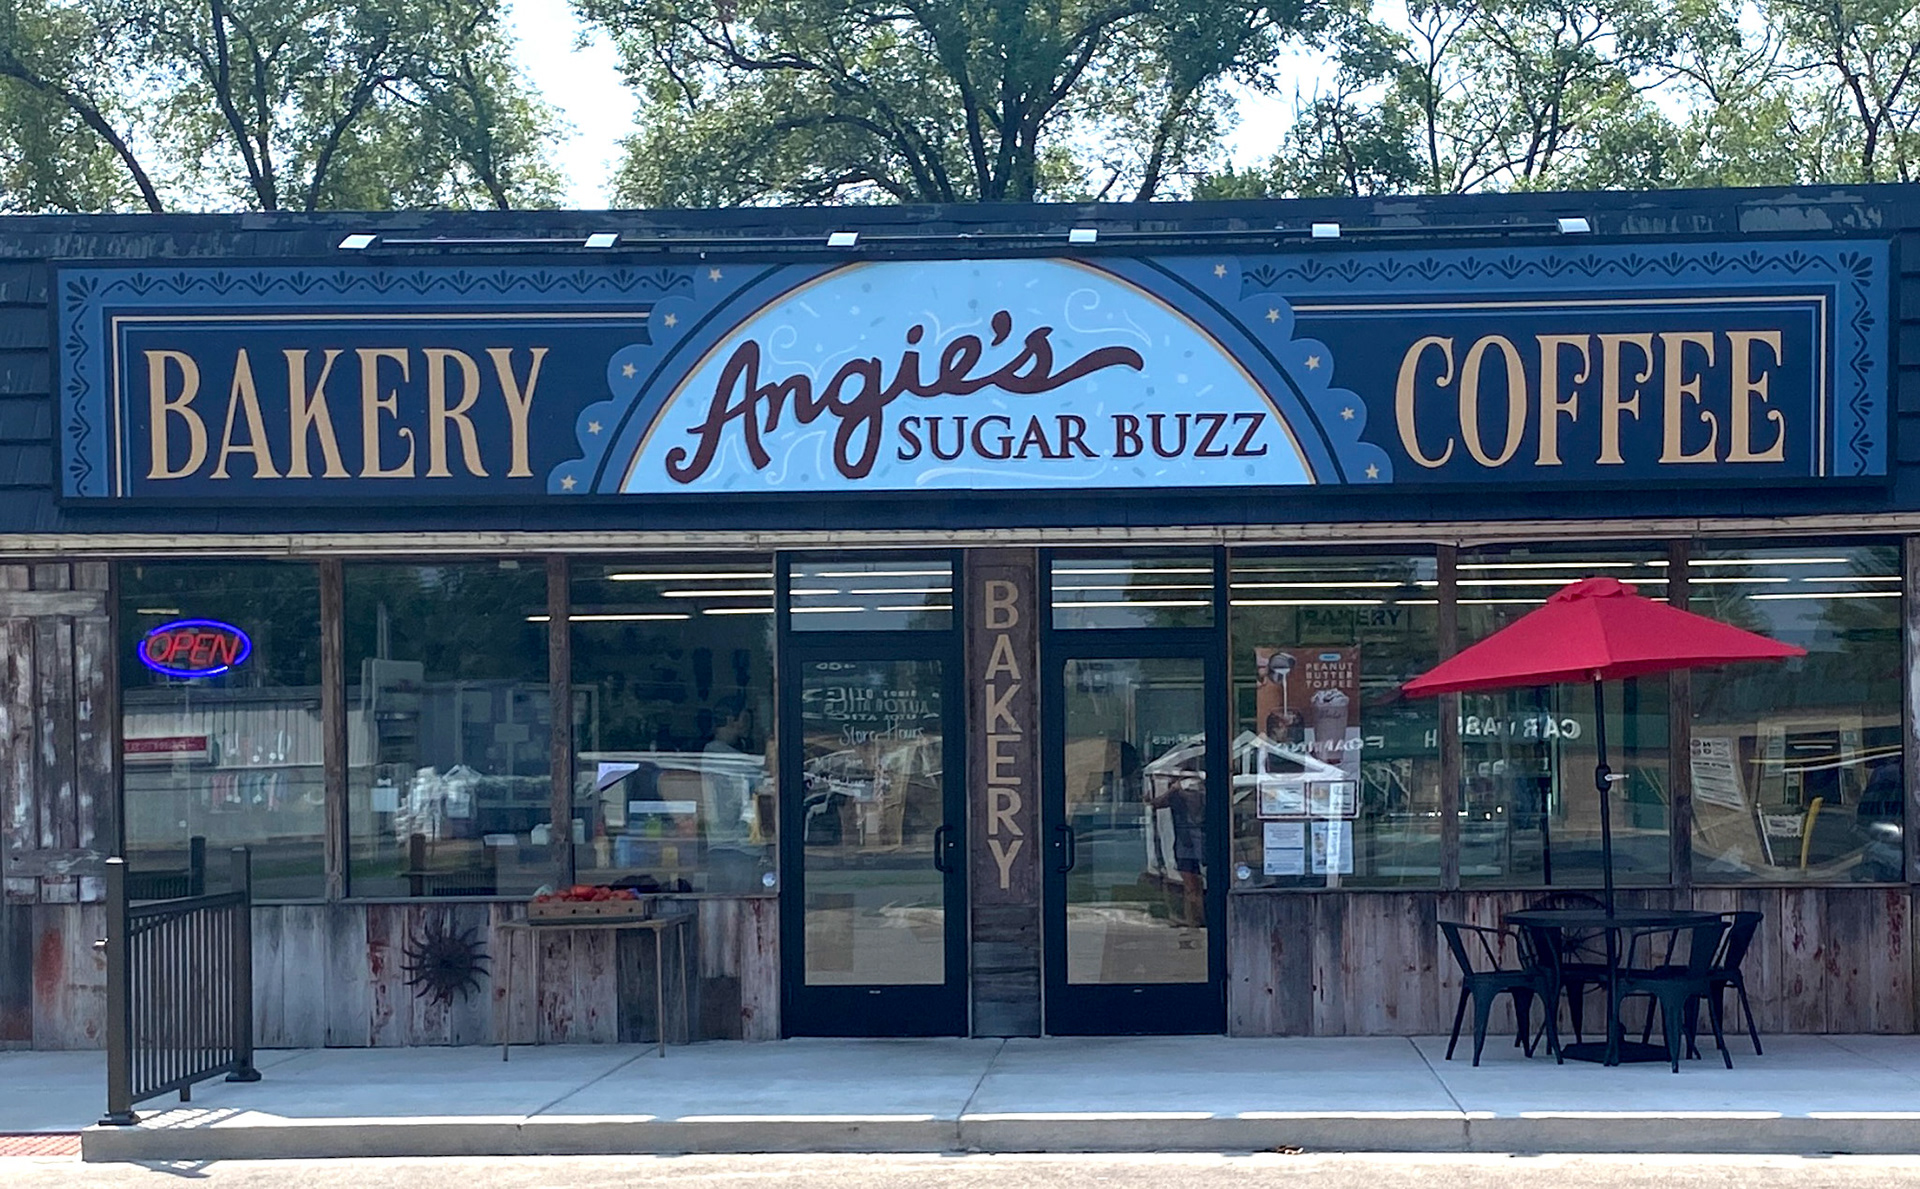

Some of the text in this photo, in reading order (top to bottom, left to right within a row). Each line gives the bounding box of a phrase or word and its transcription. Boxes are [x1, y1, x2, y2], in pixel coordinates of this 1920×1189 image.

[143, 347, 549, 480] BAKERY
[665, 310, 1144, 484] Angie's
[1395, 330, 1785, 469] COFFEE
[896, 412, 1268, 461] SUGAR BUZZ
[145, 630, 241, 666] OPEN
[1305, 662, 1354, 671] PEANUT
[1305, 671, 1354, 680] BUTTER
[1305, 680, 1354, 689] TOFFEE
[984, 579, 1024, 889] BAKERY
